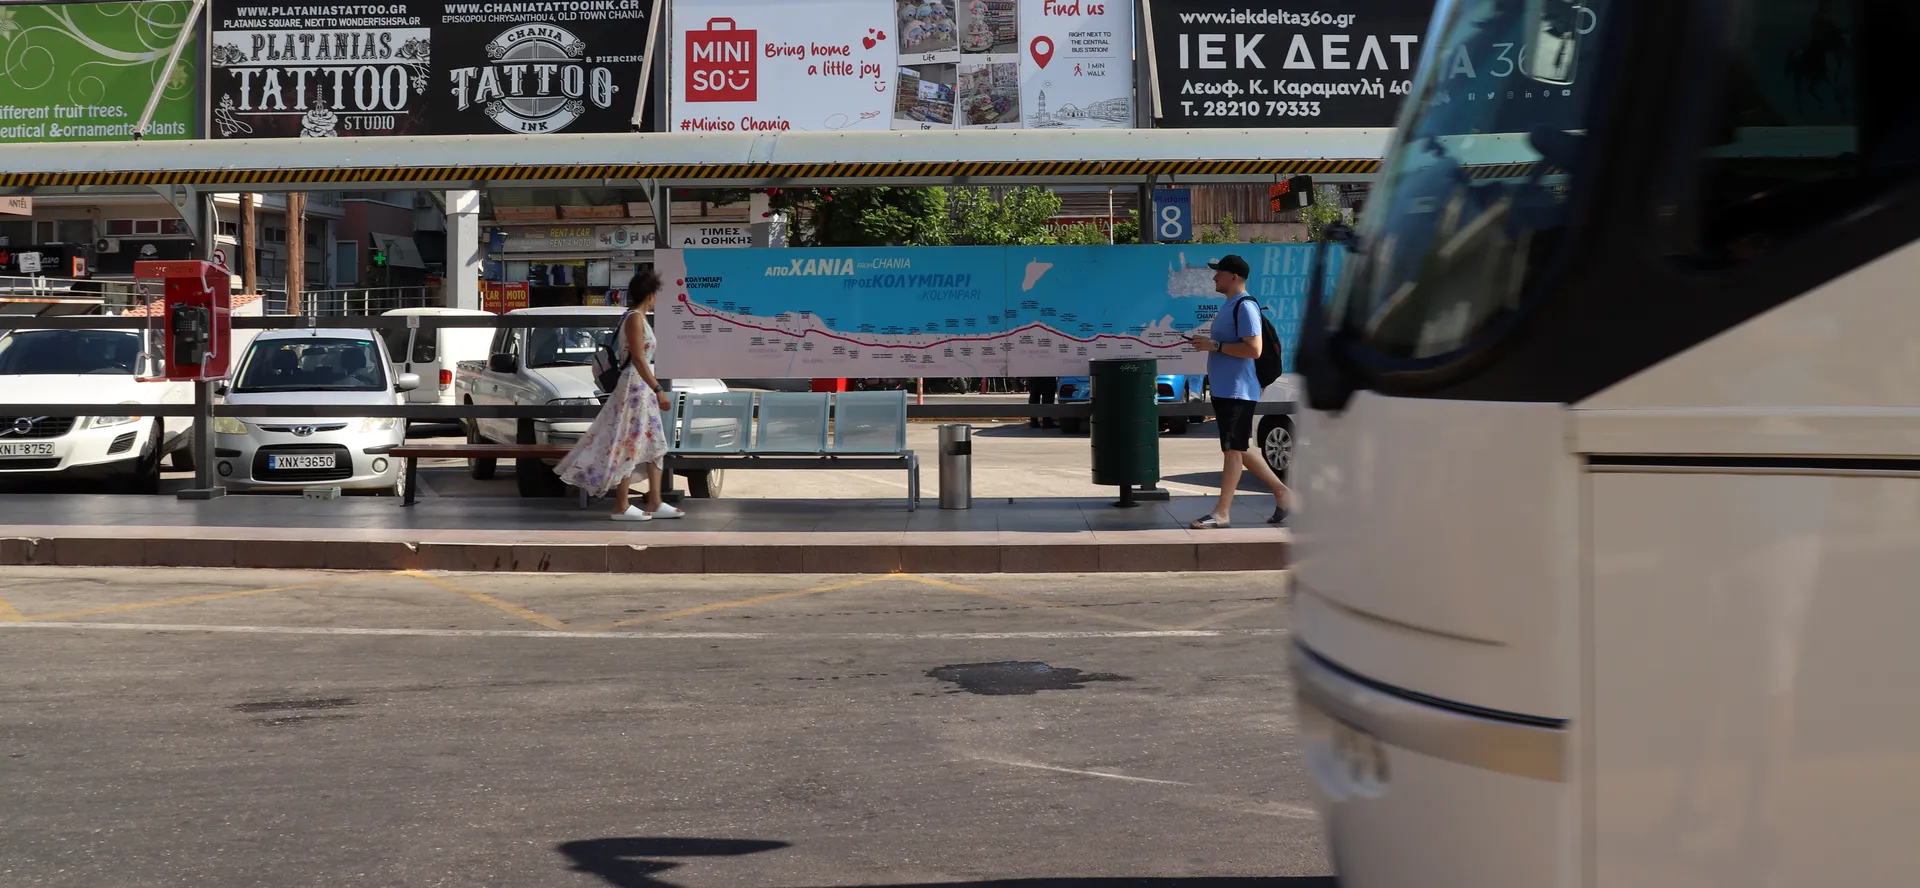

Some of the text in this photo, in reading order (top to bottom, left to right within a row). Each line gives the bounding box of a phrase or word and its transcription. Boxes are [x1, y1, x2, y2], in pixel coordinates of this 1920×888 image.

[237, 5, 407, 17] WWW.PLATANIASTATTOO.GR
[444, 0, 639, 14] WWW.CHANIATATTOOINK.GR
[1043, 0, 1105, 17] Find us
[224, 17, 420, 28] PLATANIAS SQUARE, NEXT TO WONDERFISHSPA.GR
[442, 10, 644, 23] EPISKOPOU CHRYSANTHOU 4, OLD TOWN CHANIA
[1179, 9, 1355, 28] www.iekdelta360.gr
[507, 27, 563, 42] CHANIA
[251, 32, 392, 61] PLATANIAS
[693, 41, 749, 63] MINI
[764, 42, 851, 60] Bring home
[596, 55, 643, 63] PIERCING
[923, 54, 935, 62] Life
[807, 61, 881, 79] a little joy
[228, 65, 408, 110] TATTOO
[450, 64, 619, 111] TATTOO
[1181, 79, 1244, 98] Λεωφ.
[1249, 79, 1269, 95] Κ.
[1273, 78, 1385, 98] Καραμανλή
[54, 104, 82, 118] fruit
[88, 105, 127, 118] trees,
[1203, 101, 1260, 116] 28210
[1265, 101, 1321, 116] 79333
[344, 116, 395, 130] STUDIO
[521, 121, 548, 131] INK
[680, 116, 790, 132] #Miniso Chania
[1155, 196, 1189, 204] Platform
[1161, 205, 1183, 239] 8
[550, 228, 569, 237] RENT
[577, 228, 590, 237] CAR
[550, 239, 567, 248] RENT
[574, 239, 591, 247] MOTO
[486, 290, 526, 300] CAR MOTO
[278, 456, 334, 468] XNX-3650
